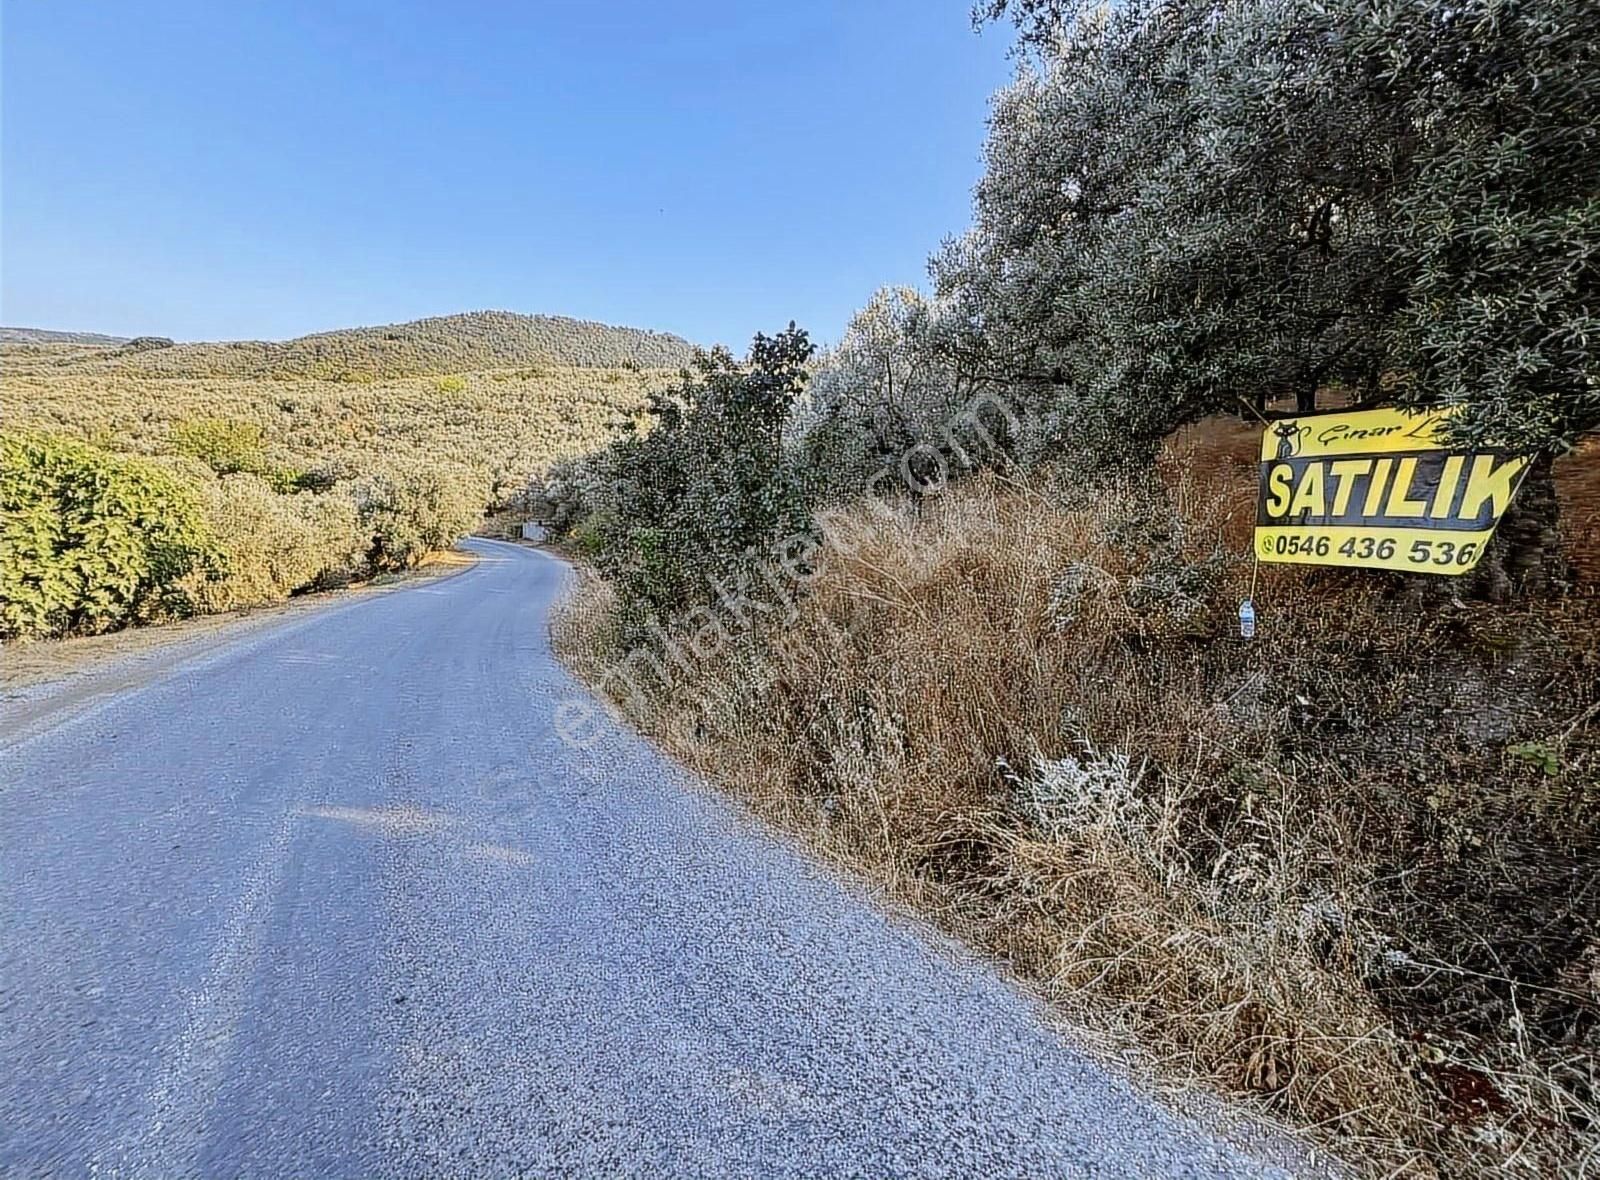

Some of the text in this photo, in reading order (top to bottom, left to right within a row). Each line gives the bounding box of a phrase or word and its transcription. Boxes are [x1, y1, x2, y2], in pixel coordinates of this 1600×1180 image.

[1266, 454, 1527, 519] SATILIK
[1276, 536, 1330, 557] 0546
[1338, 537, 1396, 560] 436
